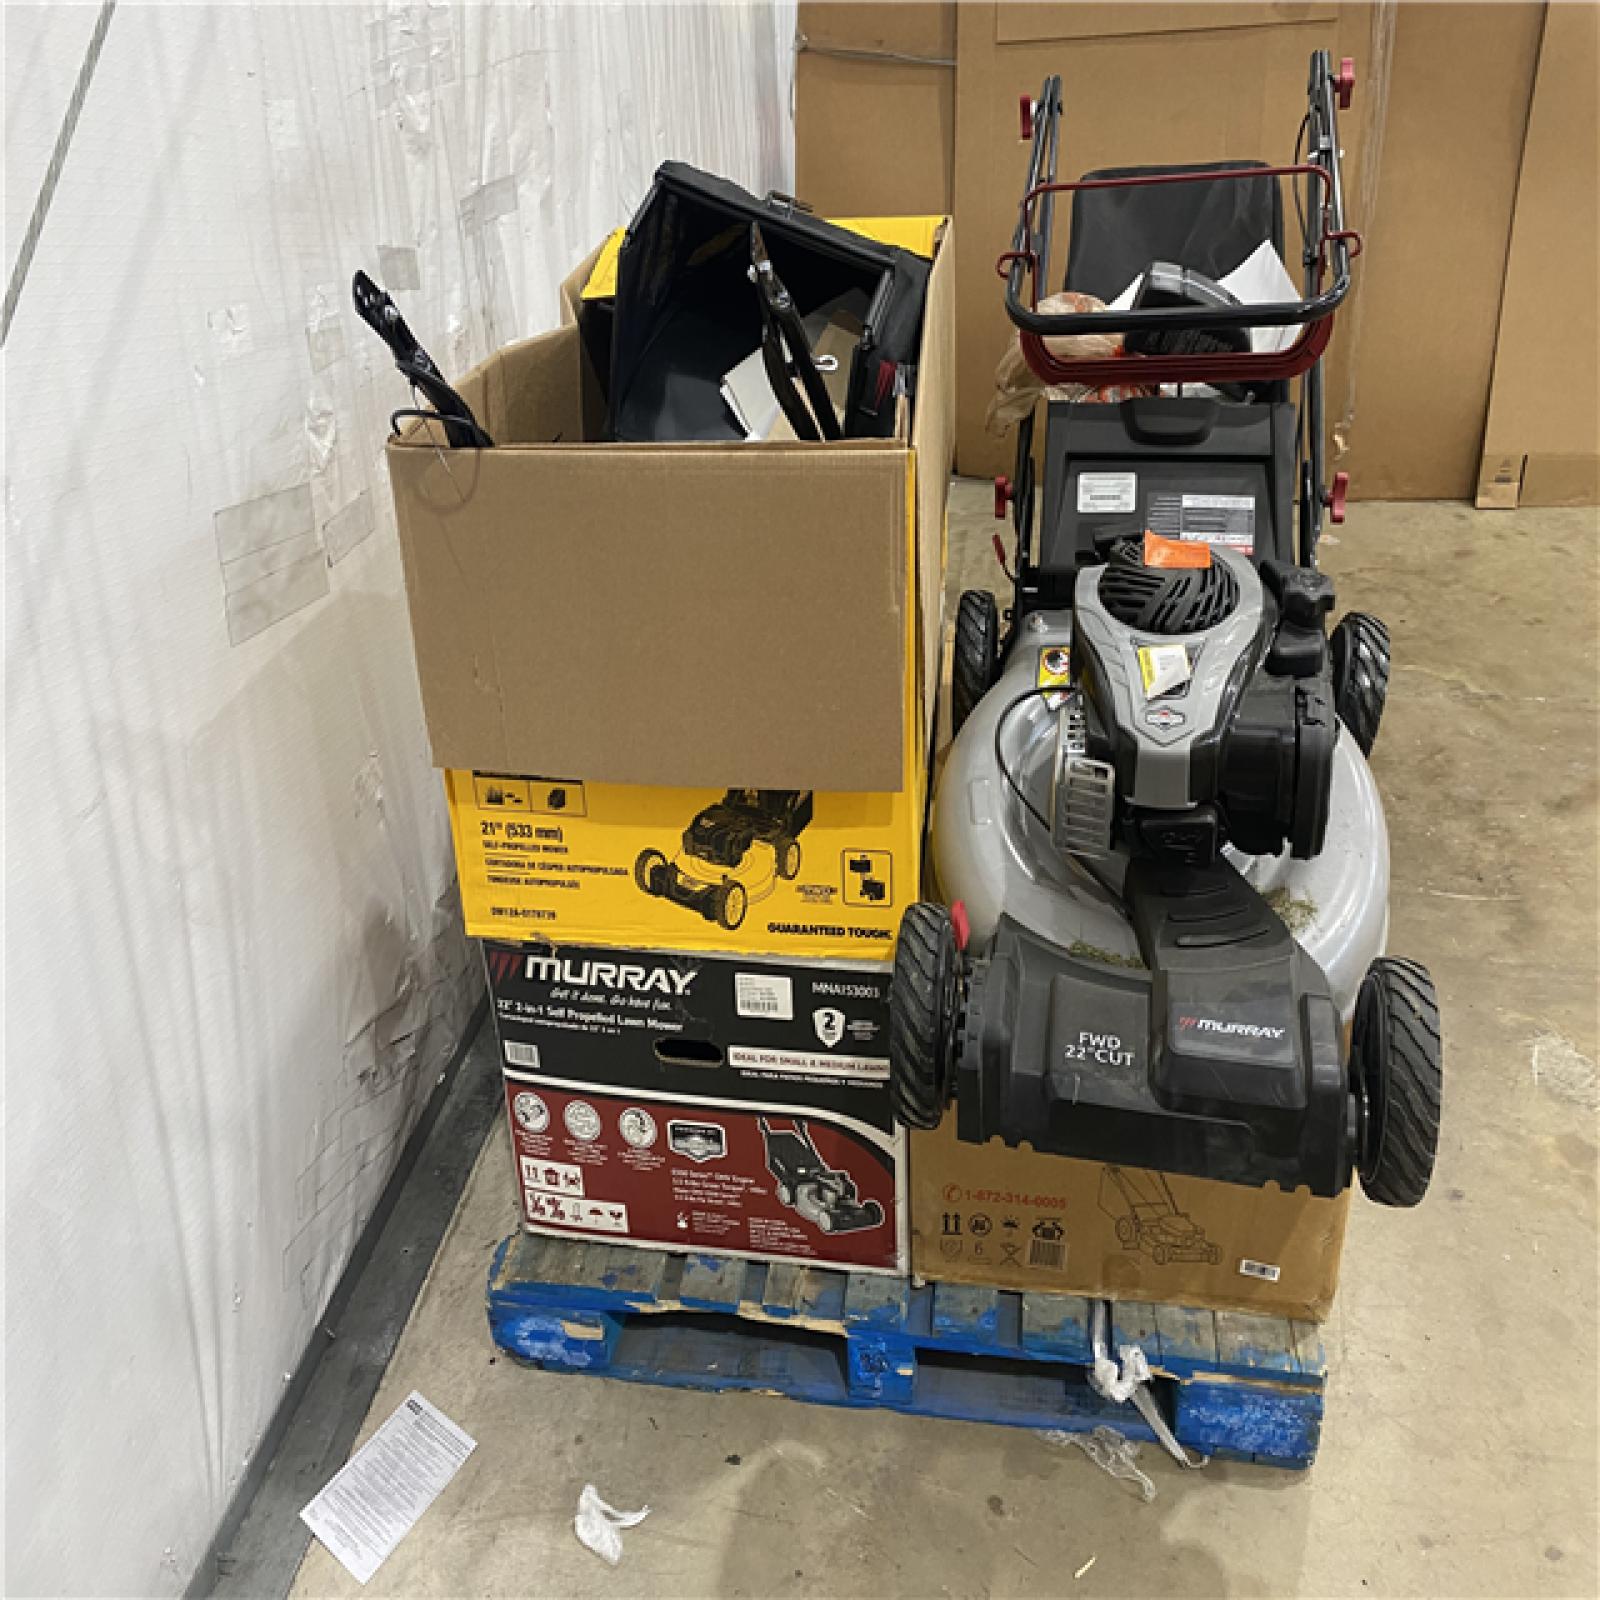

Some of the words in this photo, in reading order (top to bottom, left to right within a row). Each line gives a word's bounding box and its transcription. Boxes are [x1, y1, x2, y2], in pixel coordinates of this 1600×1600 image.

[767, 922, 846, 936] GUARANTEED
[525, 955, 698, 996] MURRAY
[567, 1008, 616, 1025] Propelled
[824, 1011, 836, 1031] 2
[1079, 1031, 1121, 1050] FWD
